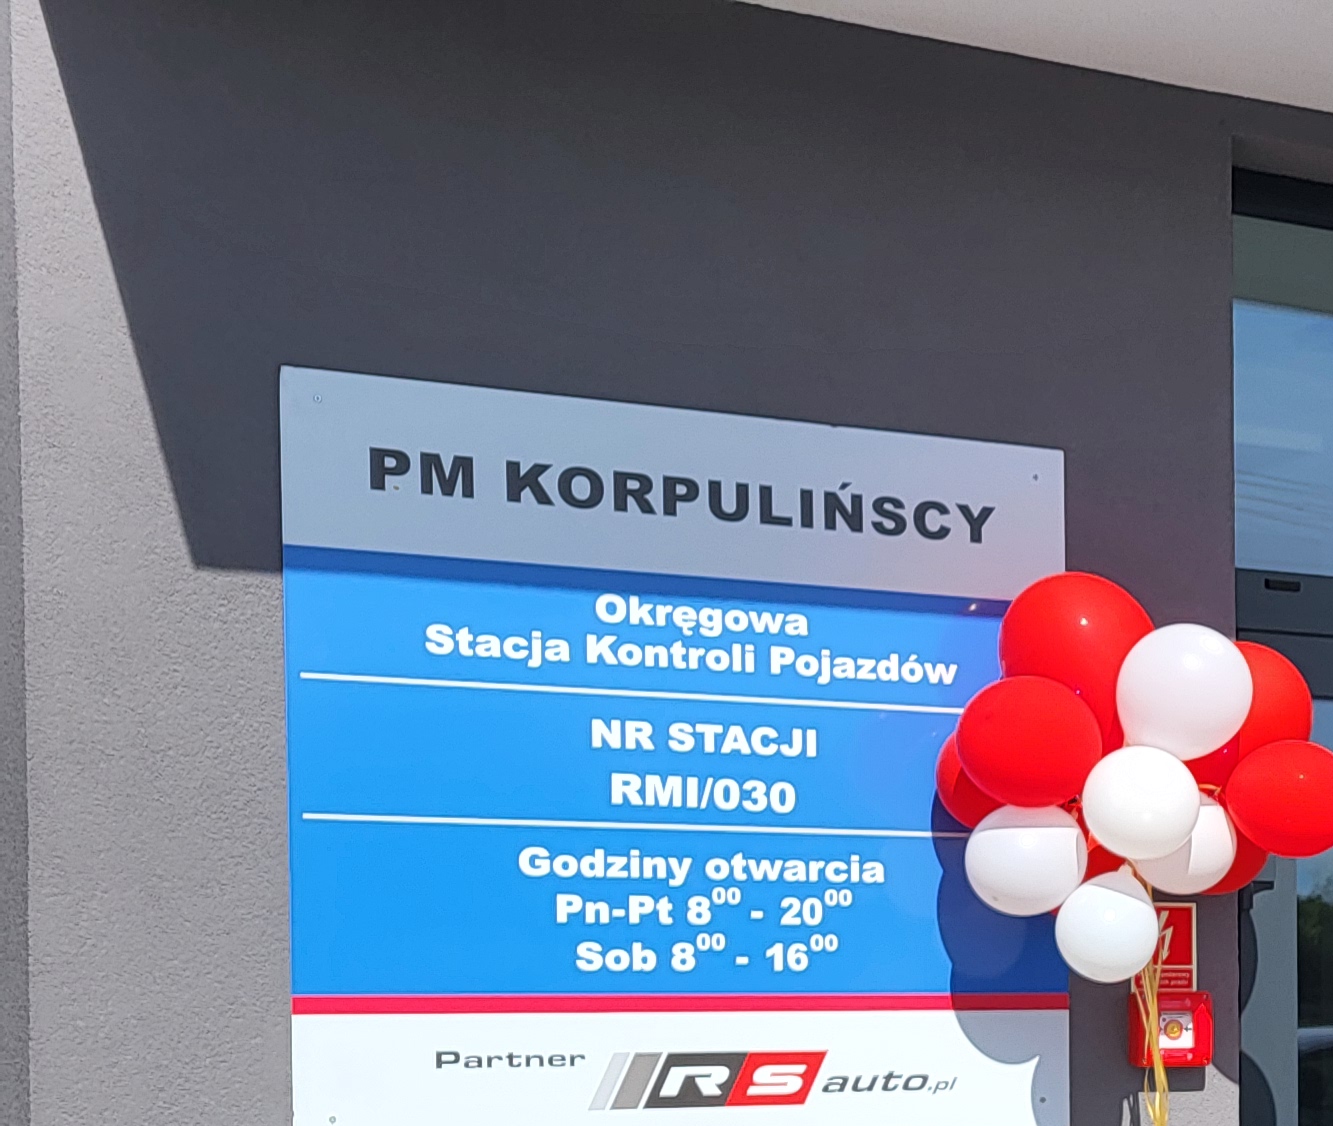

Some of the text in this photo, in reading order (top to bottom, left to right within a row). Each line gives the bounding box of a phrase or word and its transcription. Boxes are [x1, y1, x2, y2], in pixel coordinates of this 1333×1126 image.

[369, 446, 996, 544] PM KORPULIŃSCY
[594, 593, 809, 637] Okręgowa
[425, 623, 958, 686] Stacja Kontroli Pojazdów
[591, 718, 817, 758] NR STACJI
[611, 773, 796, 814] RMI/030
[518, 846, 885, 887] Godziny otwarcia
[556, 893, 674, 925] Pn-Pt
[750, 910, 764, 920] -
[575, 941, 657, 972] Sob
[735, 955, 749, 965] -
[435, 1050, 957, 1098] Partner RS auto.pl
